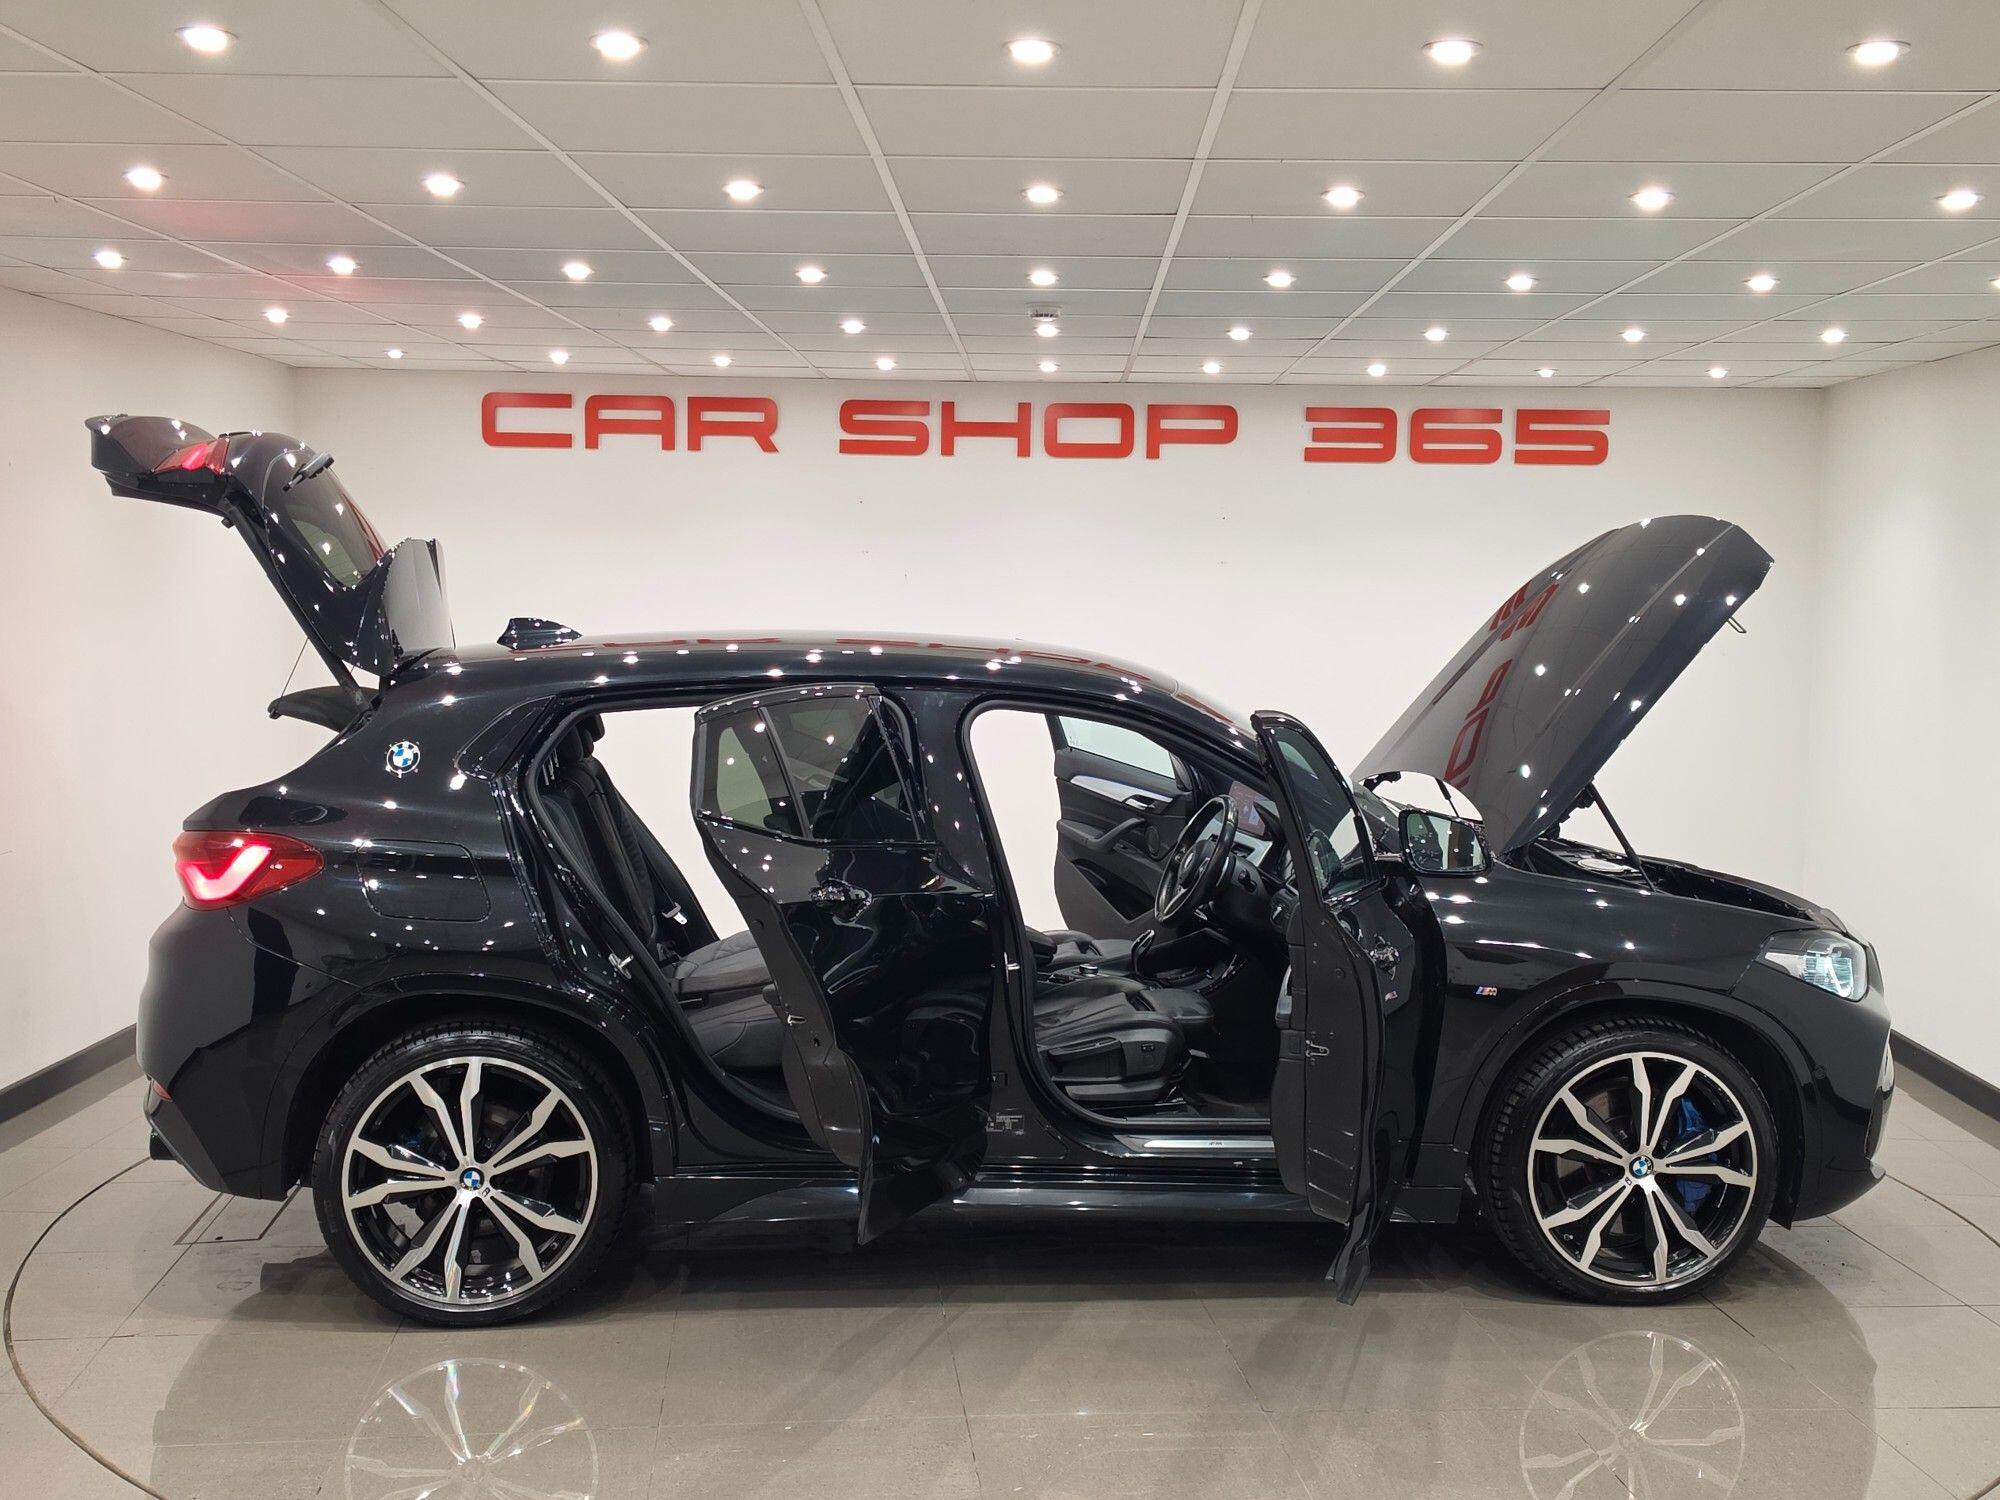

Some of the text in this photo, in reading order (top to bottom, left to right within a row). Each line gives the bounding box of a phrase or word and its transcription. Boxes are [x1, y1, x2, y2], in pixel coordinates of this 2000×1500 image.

[481, 391, 1609, 465] CAR SHOP 365
